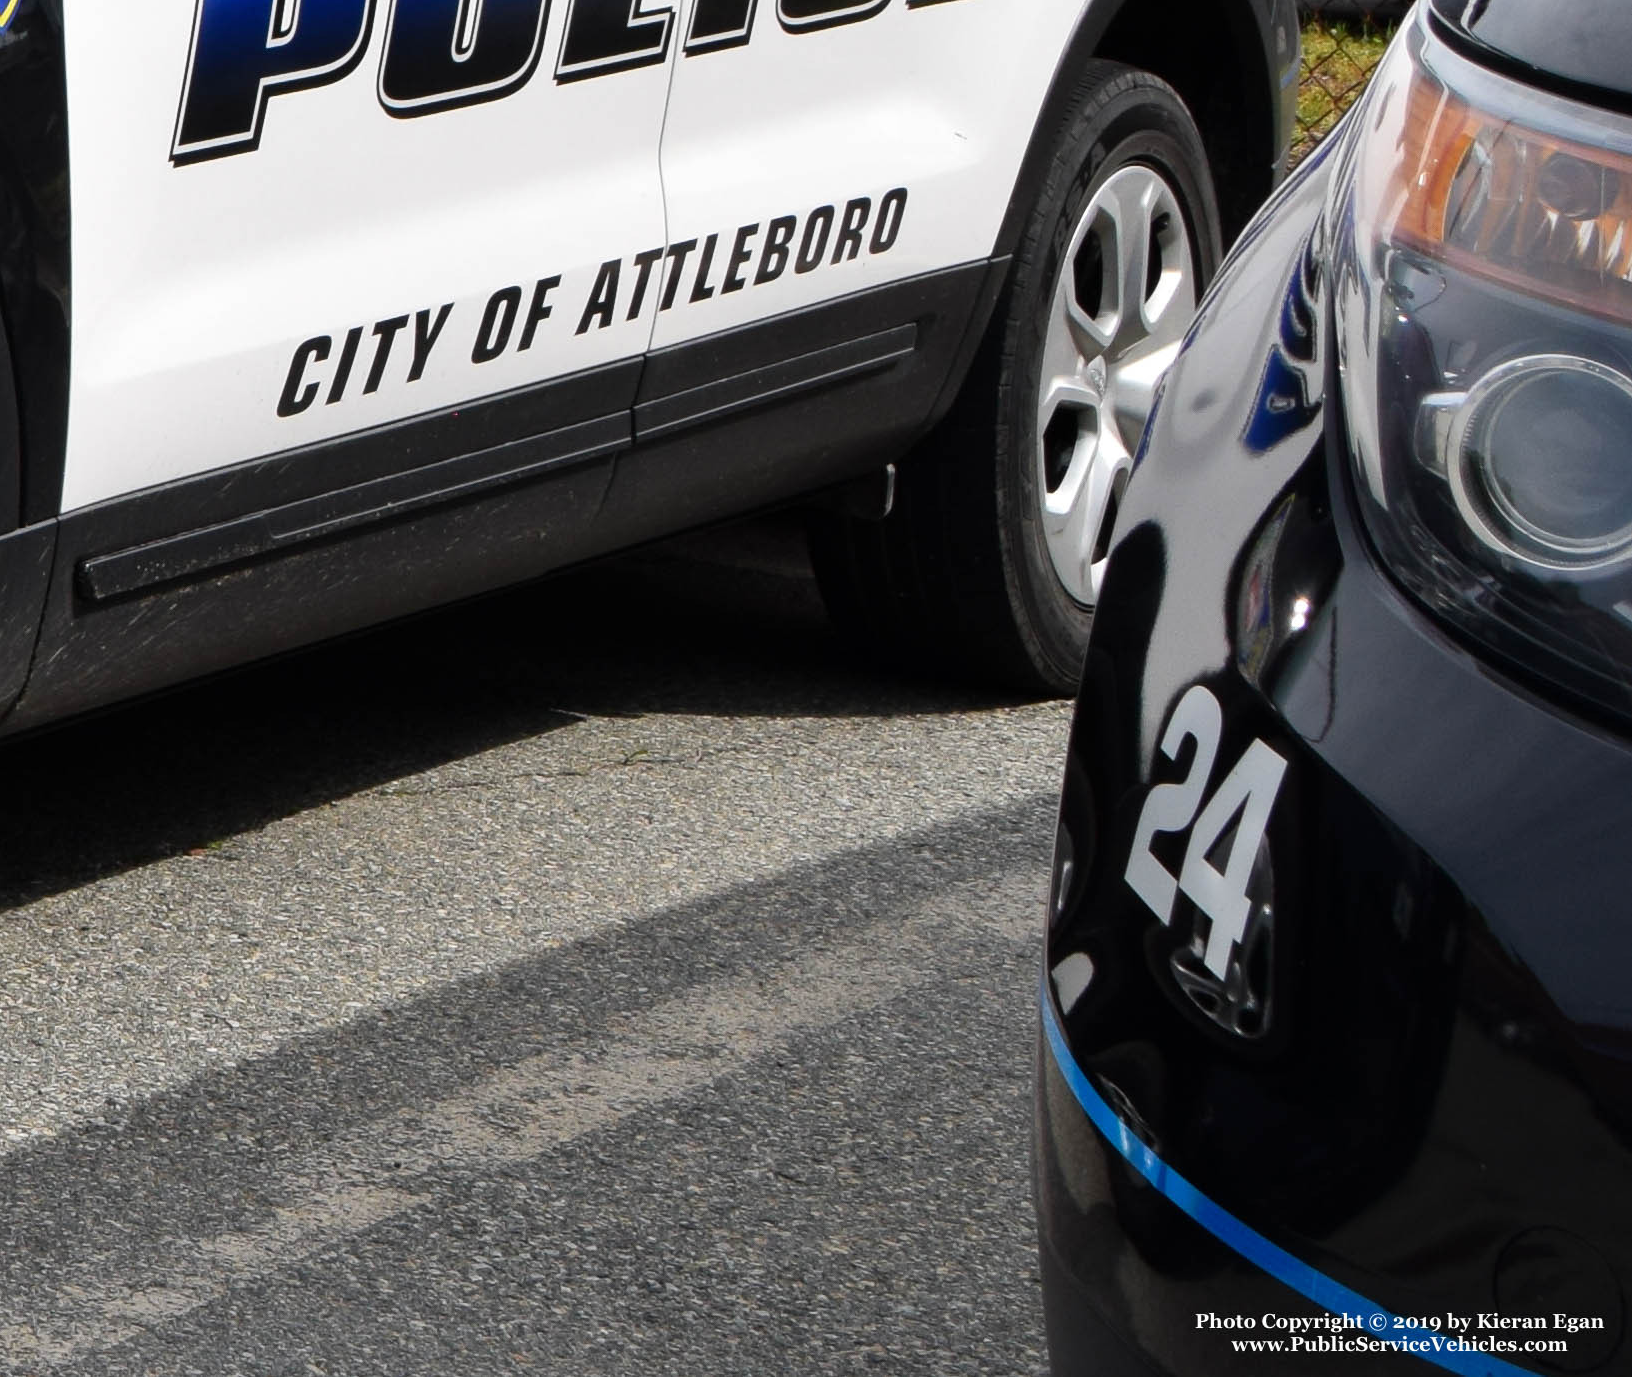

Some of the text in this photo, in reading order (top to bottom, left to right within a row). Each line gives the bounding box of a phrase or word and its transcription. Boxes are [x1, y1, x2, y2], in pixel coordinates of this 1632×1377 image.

[276, 187, 909, 418] CITY OF ATTLEBORO
[1124, 684, 1289, 981] 24
